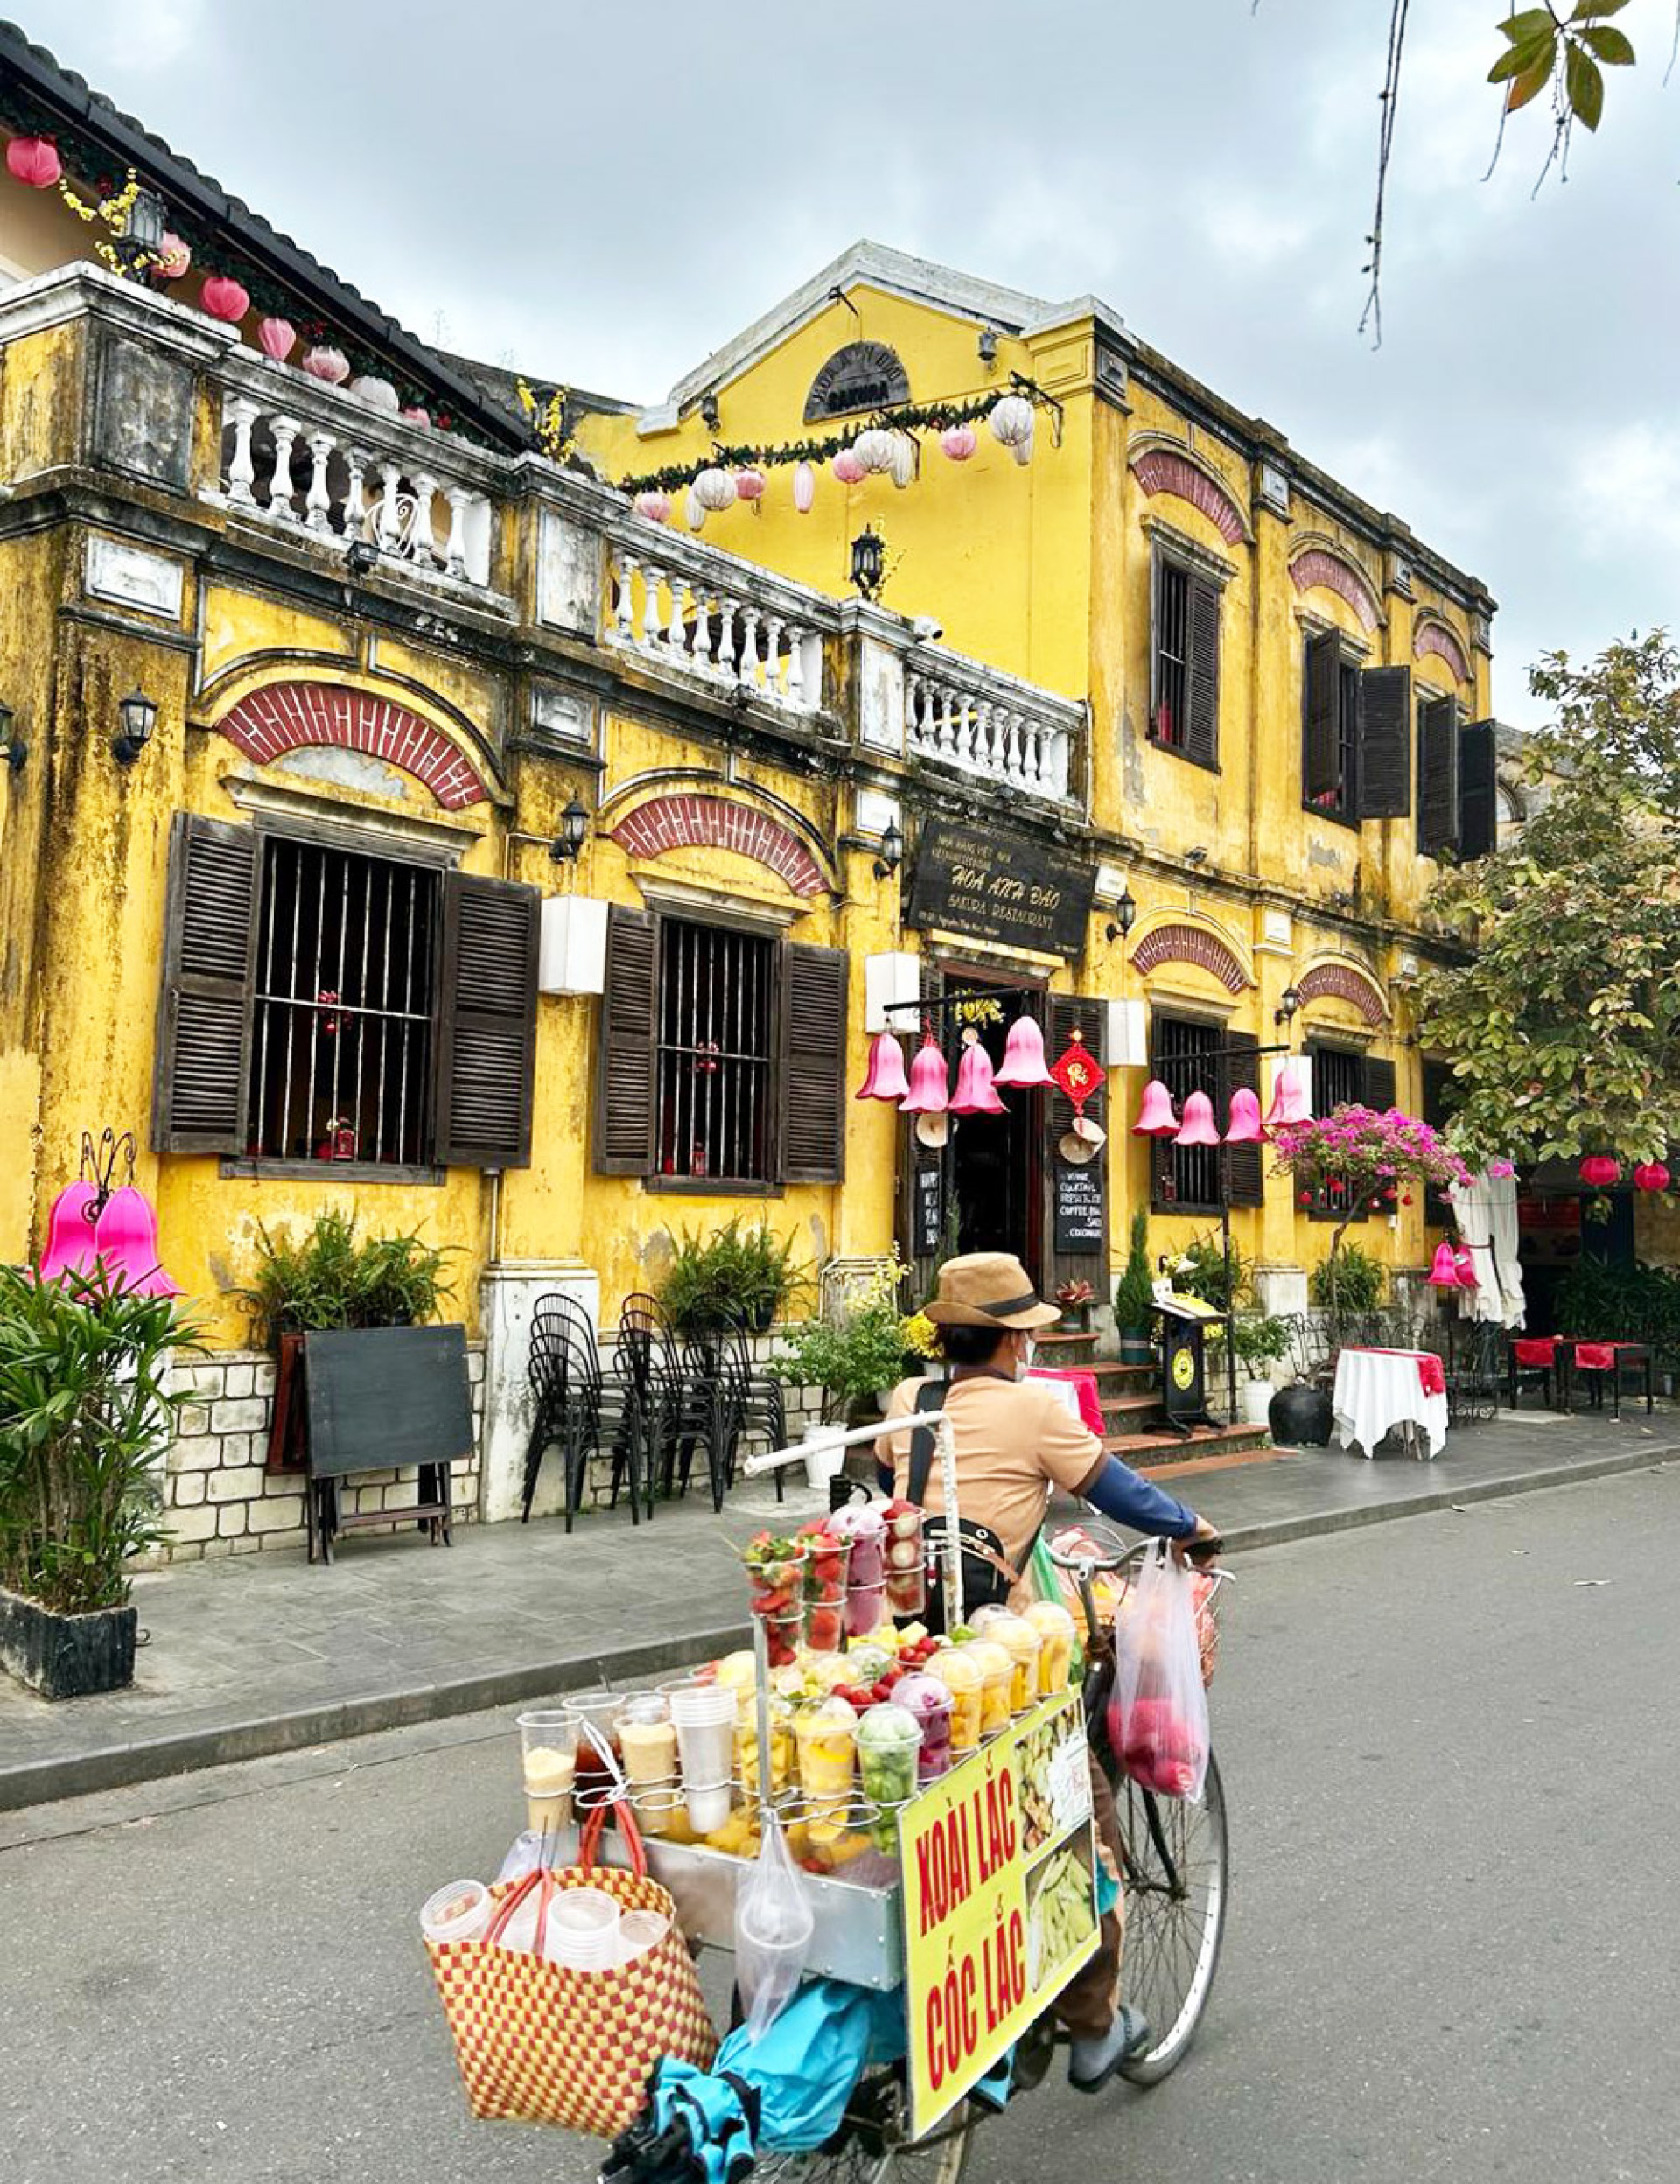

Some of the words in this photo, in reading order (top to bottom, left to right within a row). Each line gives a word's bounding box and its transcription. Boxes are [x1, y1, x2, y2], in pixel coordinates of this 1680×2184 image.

[951, 864, 987, 892] HOA
[987, 876, 1026, 901] ANH
[992, 903, 1054, 930] RESTAURANT
[915, 1796, 972, 1938] XOÀI
[973, 1748, 1016, 1885] LẮC
[927, 1934, 977, 2092] CỐC
[982, 1892, 1026, 2034] LẮC
